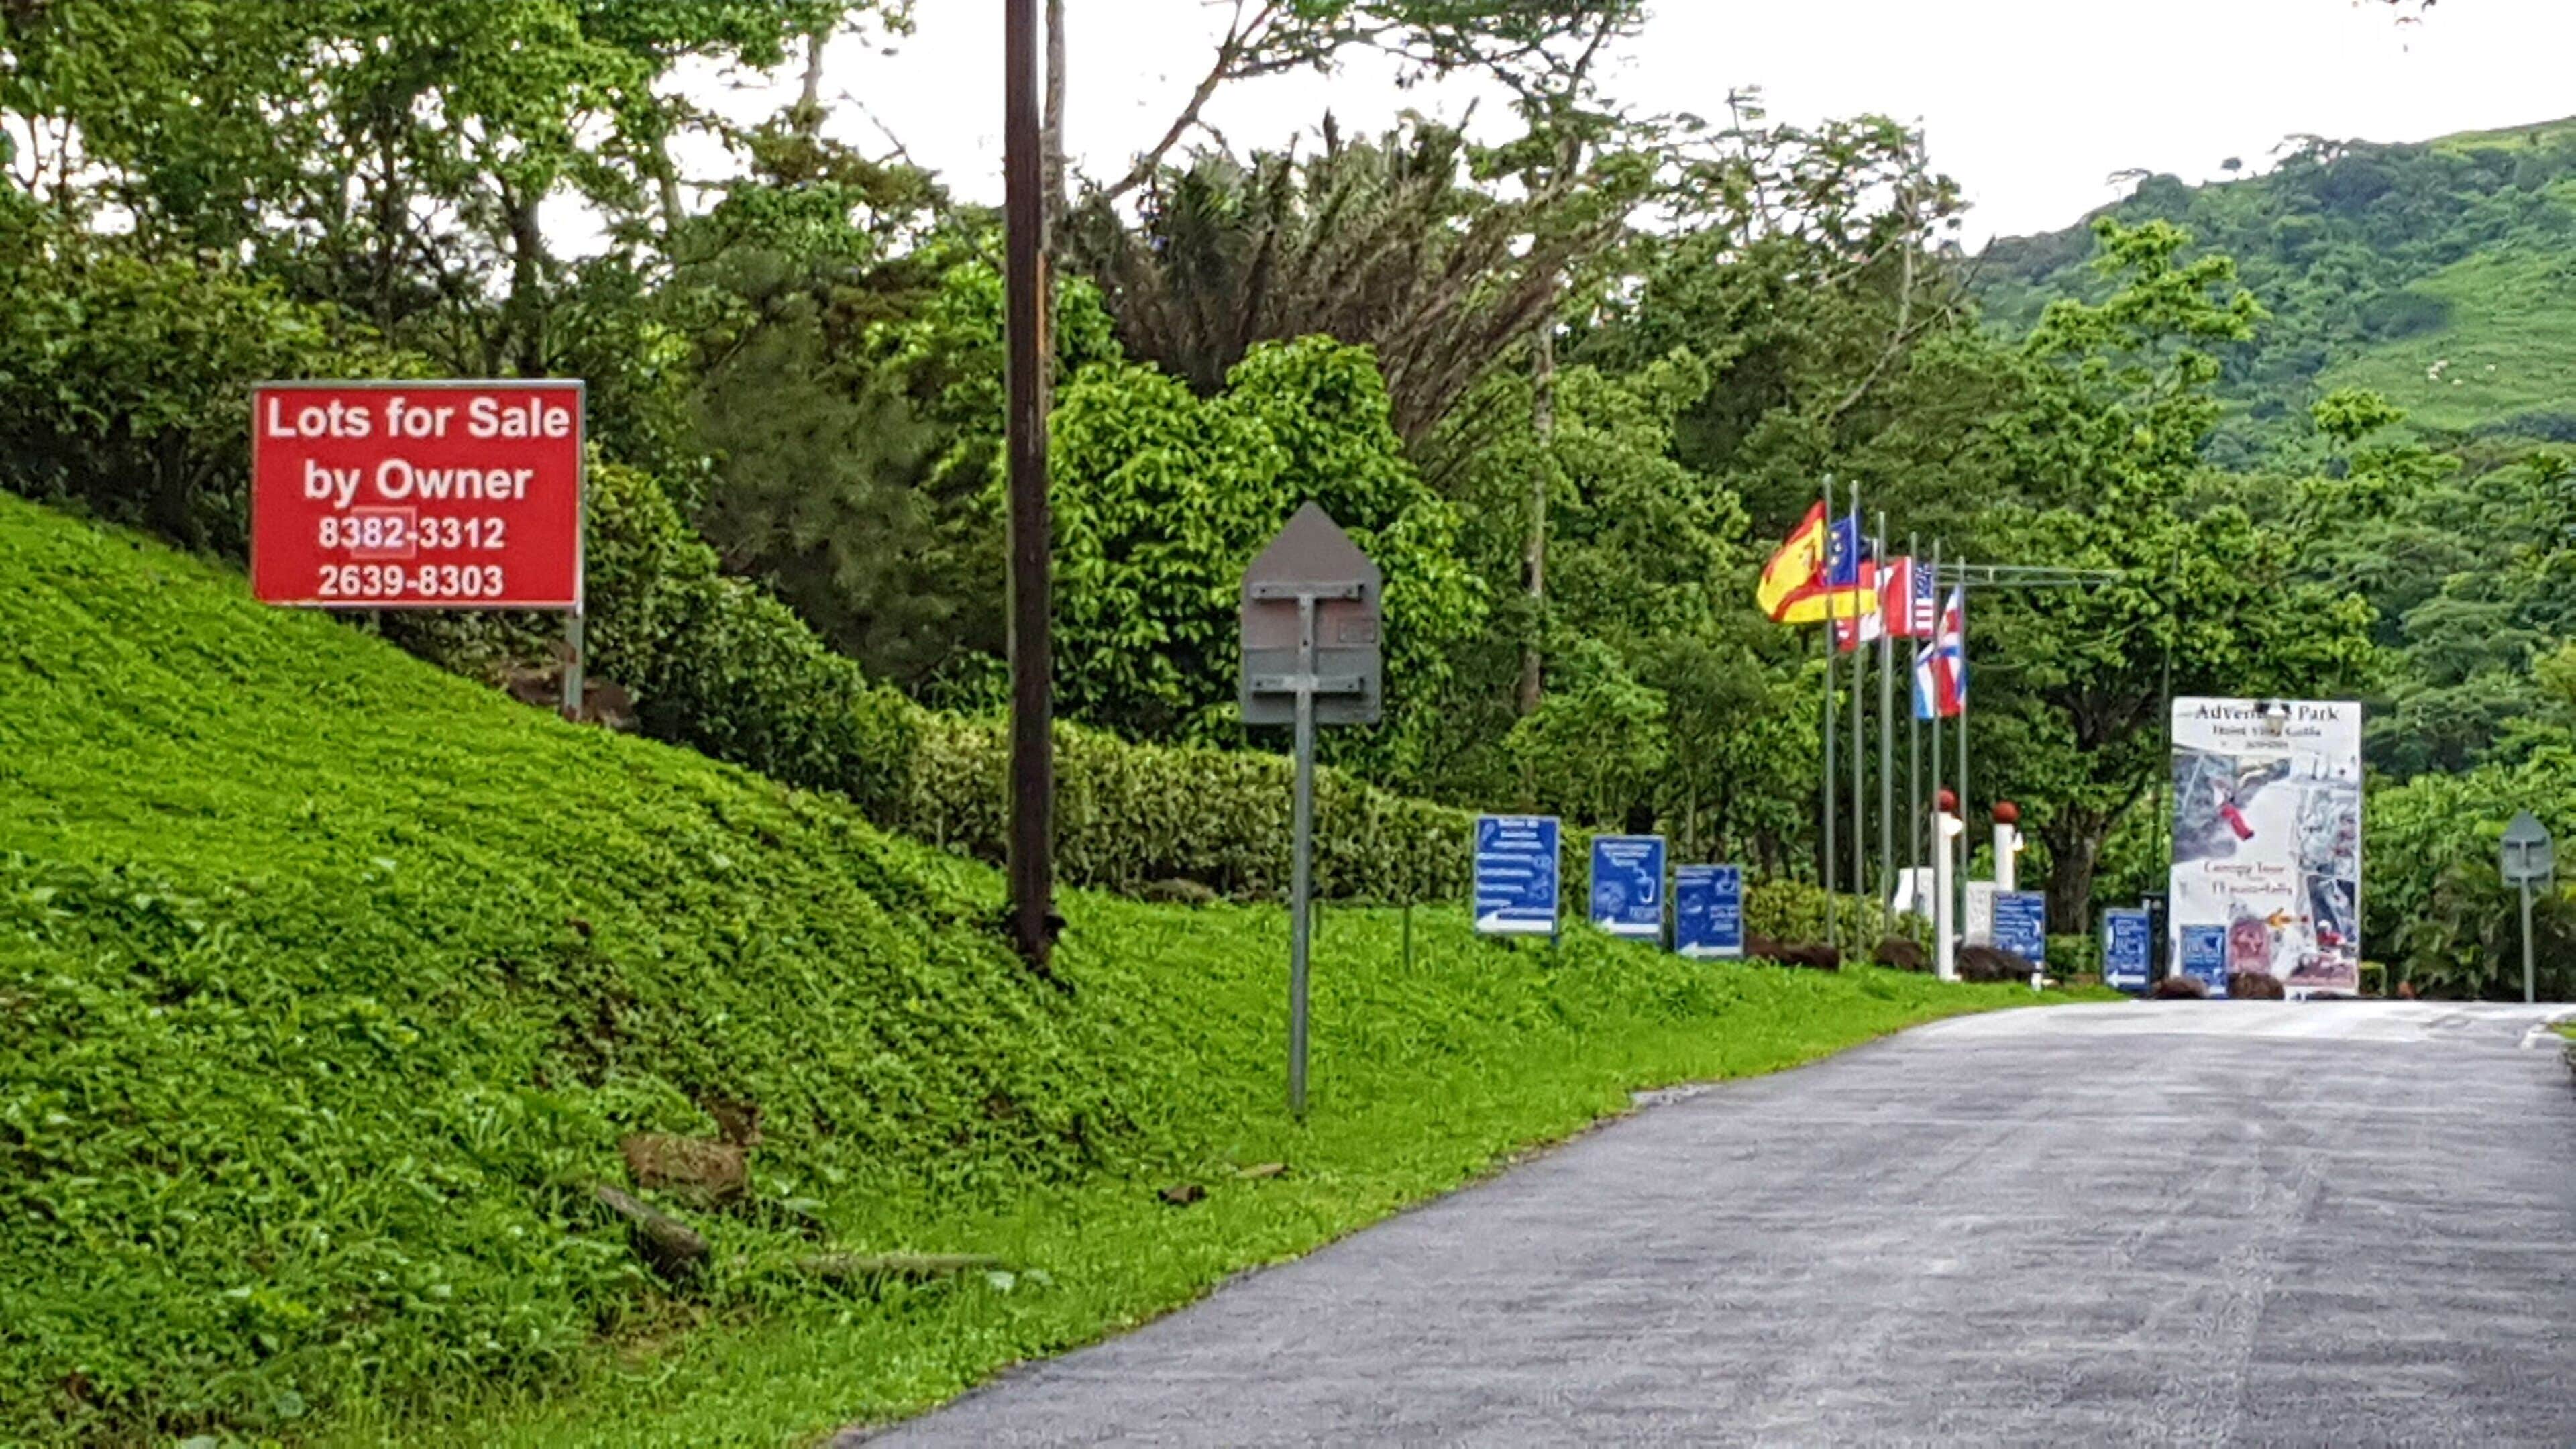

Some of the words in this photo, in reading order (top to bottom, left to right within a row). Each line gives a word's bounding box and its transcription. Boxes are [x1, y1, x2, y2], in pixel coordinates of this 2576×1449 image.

[268, 397, 370, 437] Lots
[386, 397, 454, 437] for
[468, 396, 570, 437] Sale
[305, 459, 360, 508] by
[376, 458, 532, 499] Owner
[319, 517, 505, 549] 8382-3312
[319, 565, 504, 596] 2639-8303
[2298, 705, 2340, 722] Park
